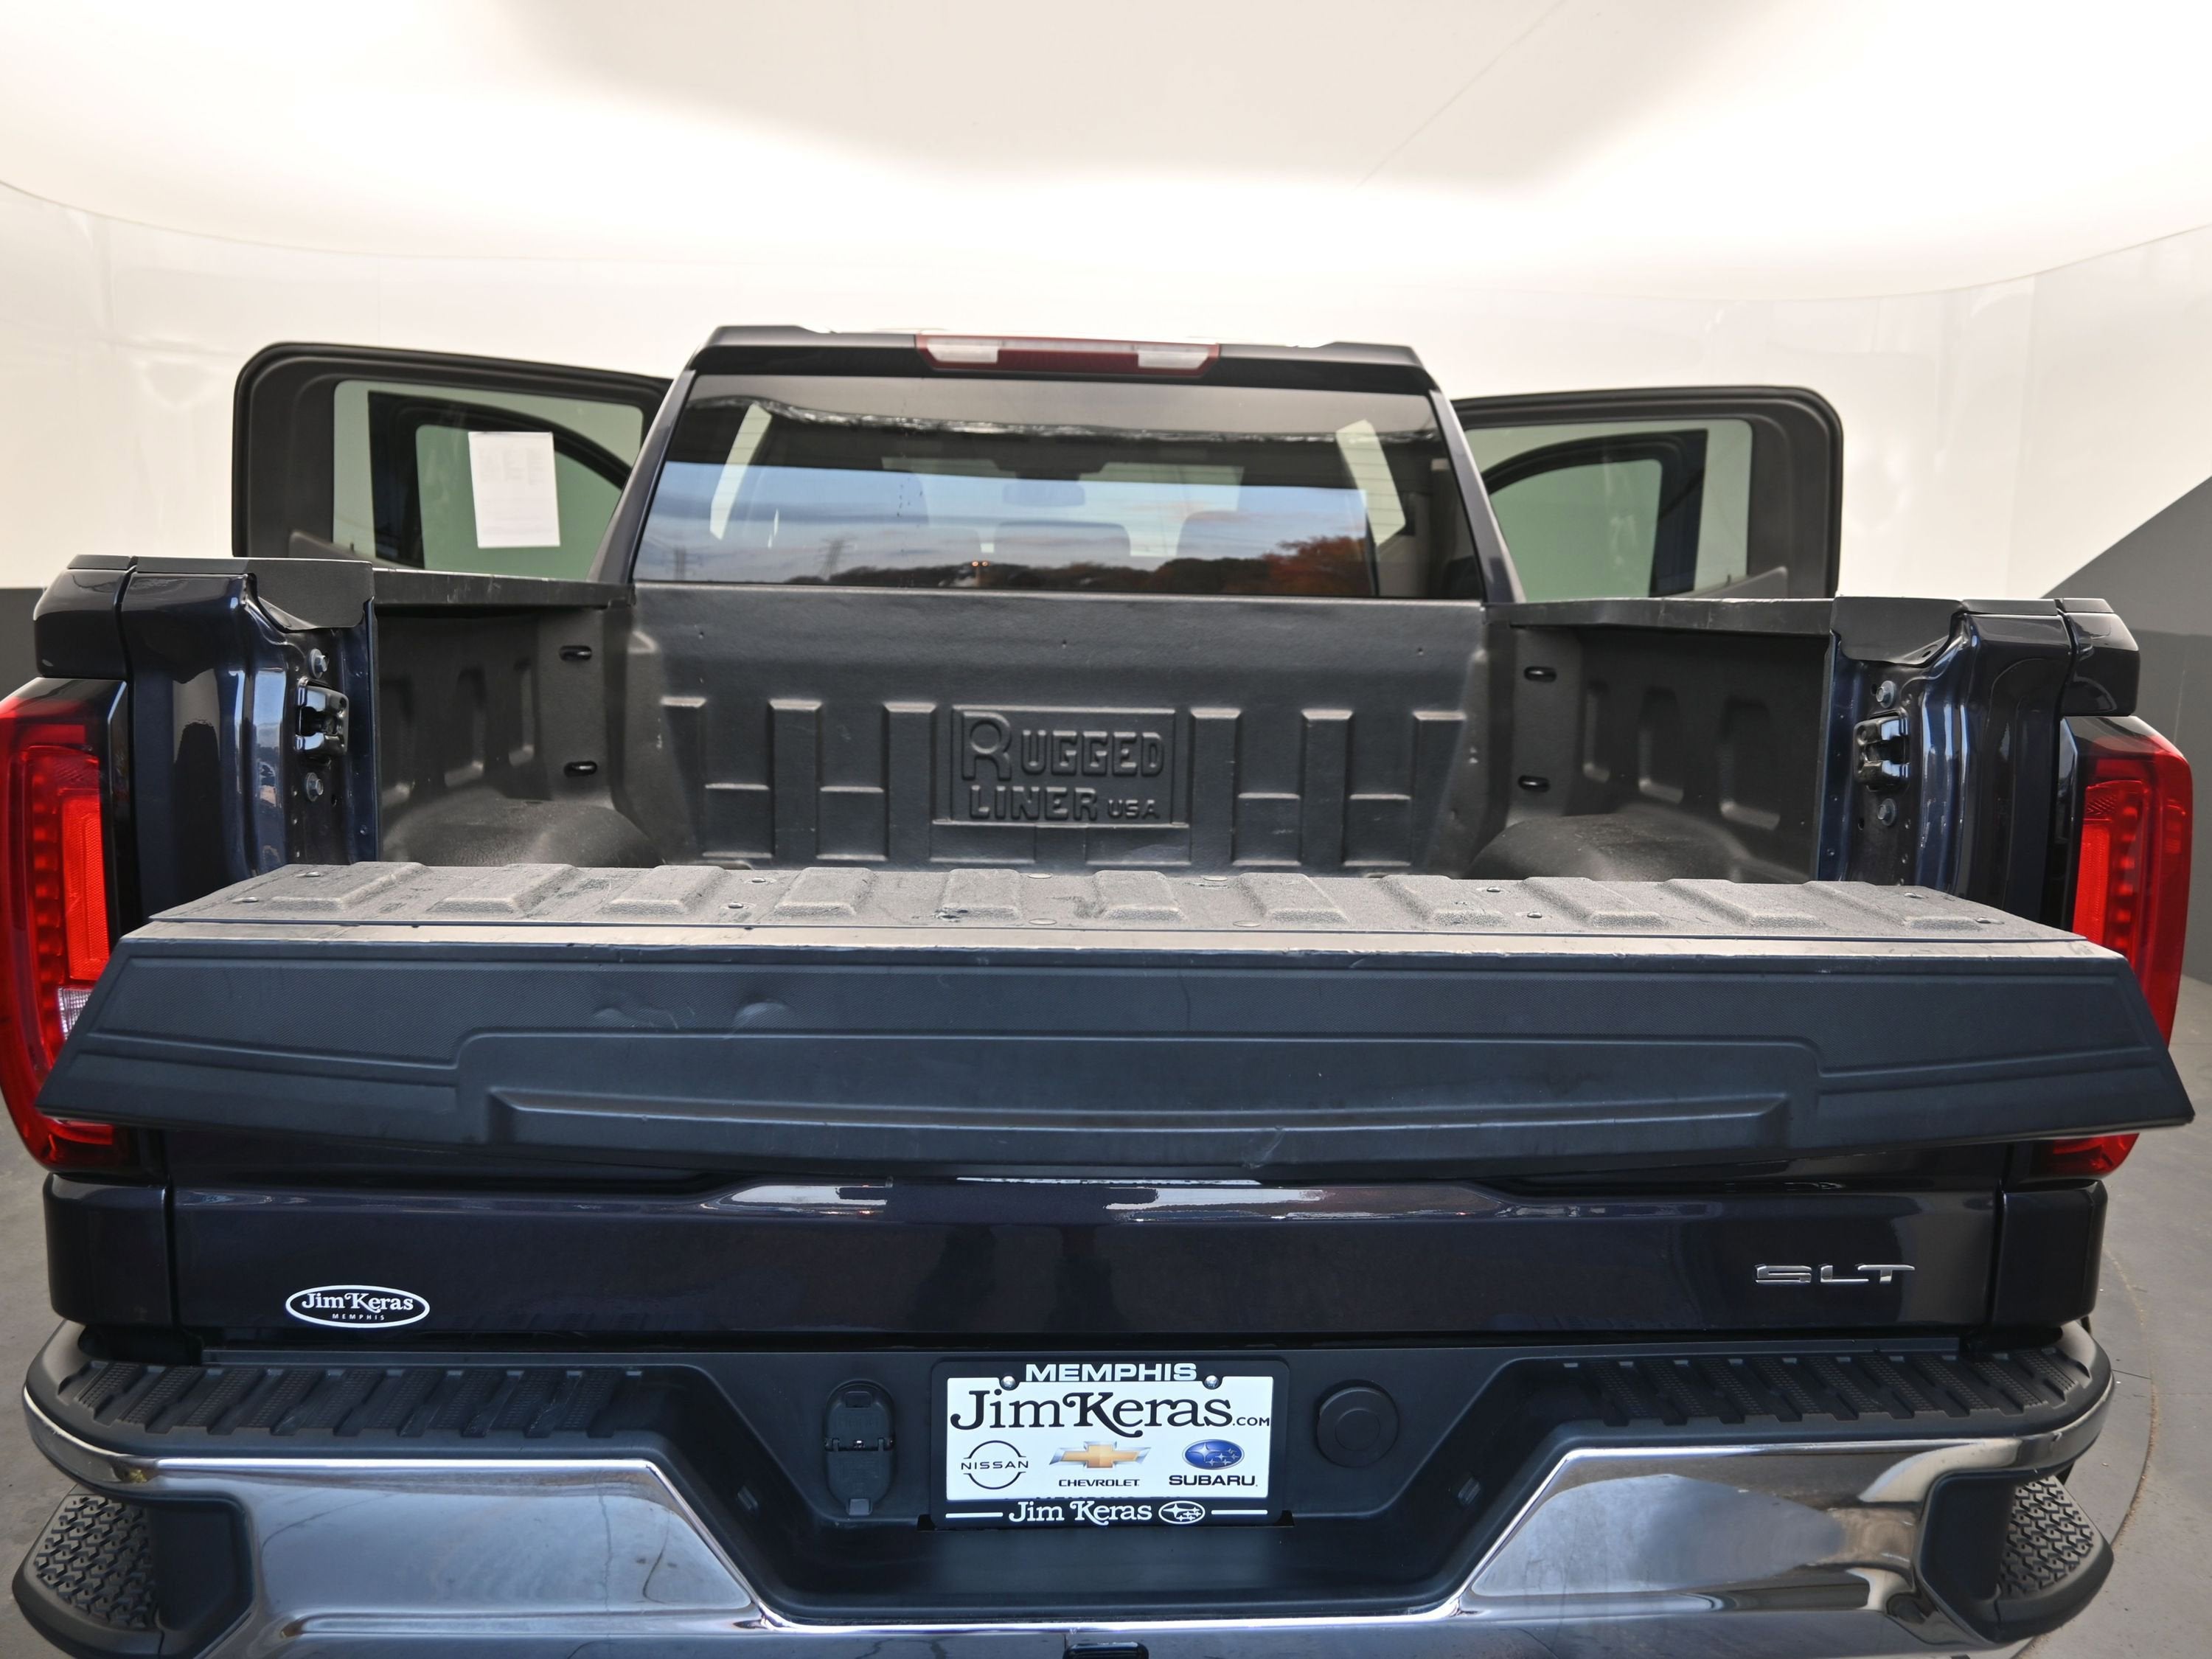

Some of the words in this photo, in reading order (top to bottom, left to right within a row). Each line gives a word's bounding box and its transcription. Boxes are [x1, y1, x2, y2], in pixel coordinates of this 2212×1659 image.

[969, 784, 1098, 821] LINER
[1107, 799, 1161, 820] USA
[1754, 1263, 1916, 1284] SLT
[1026, 1363, 1197, 1382] MEMPHIS
[961, 1460, 1029, 1470] NISSAN
[1058, 1479, 1139, 1487] CHEVROLET
[1169, 1475, 1256, 1486] SUBARU
[1008, 1501, 1065, 1522] Jim
[1070, 1501, 1152, 1526] Keras
